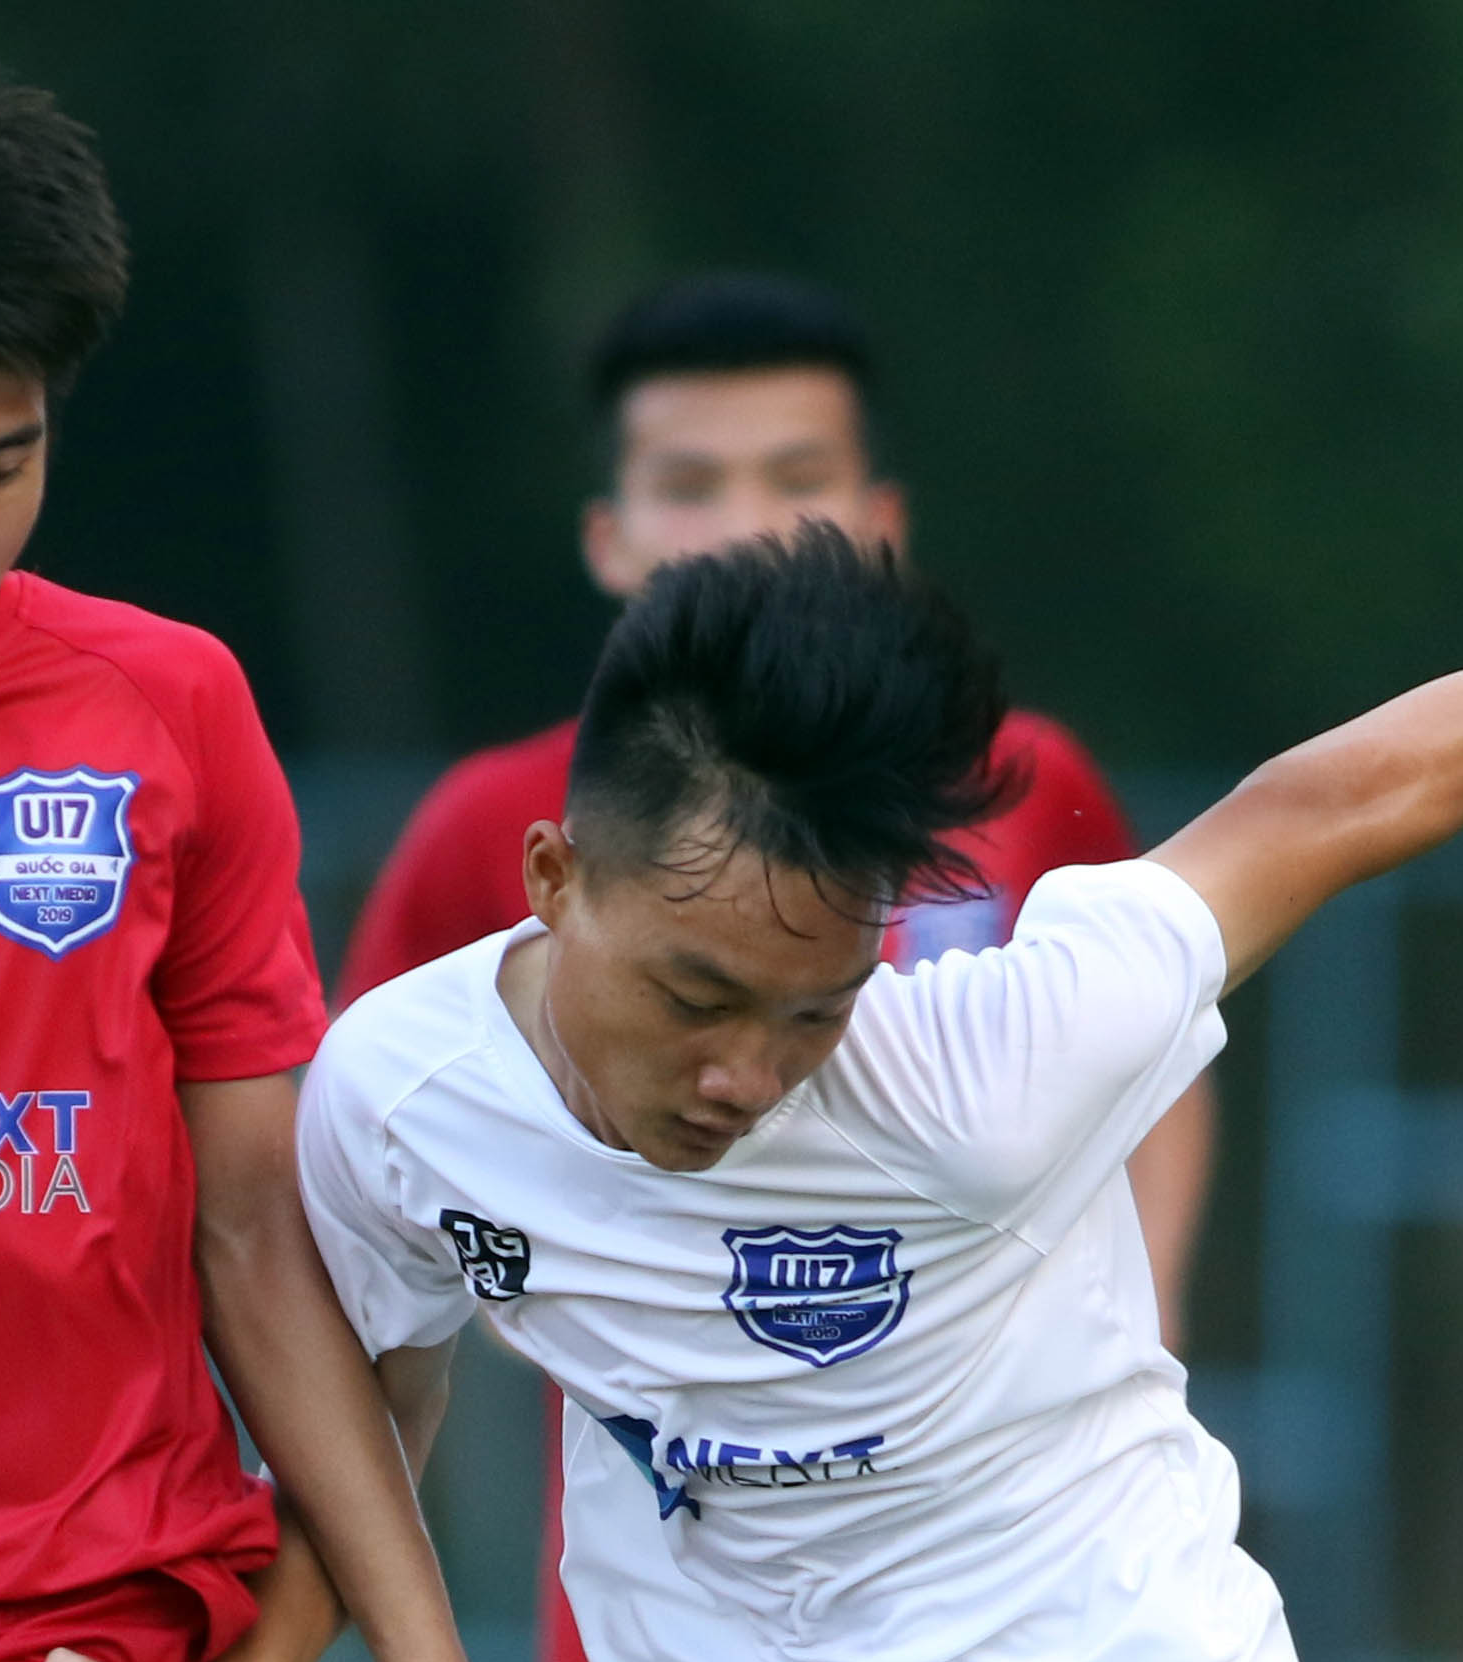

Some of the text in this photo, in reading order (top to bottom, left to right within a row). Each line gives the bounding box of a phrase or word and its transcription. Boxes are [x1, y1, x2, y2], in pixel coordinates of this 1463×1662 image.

[20, 799, 90, 839] U17
[69, 861, 97, 875] GIA
[12, 886, 97, 902] NEXT MEDIA
[39, 907, 72, 923] 2019
